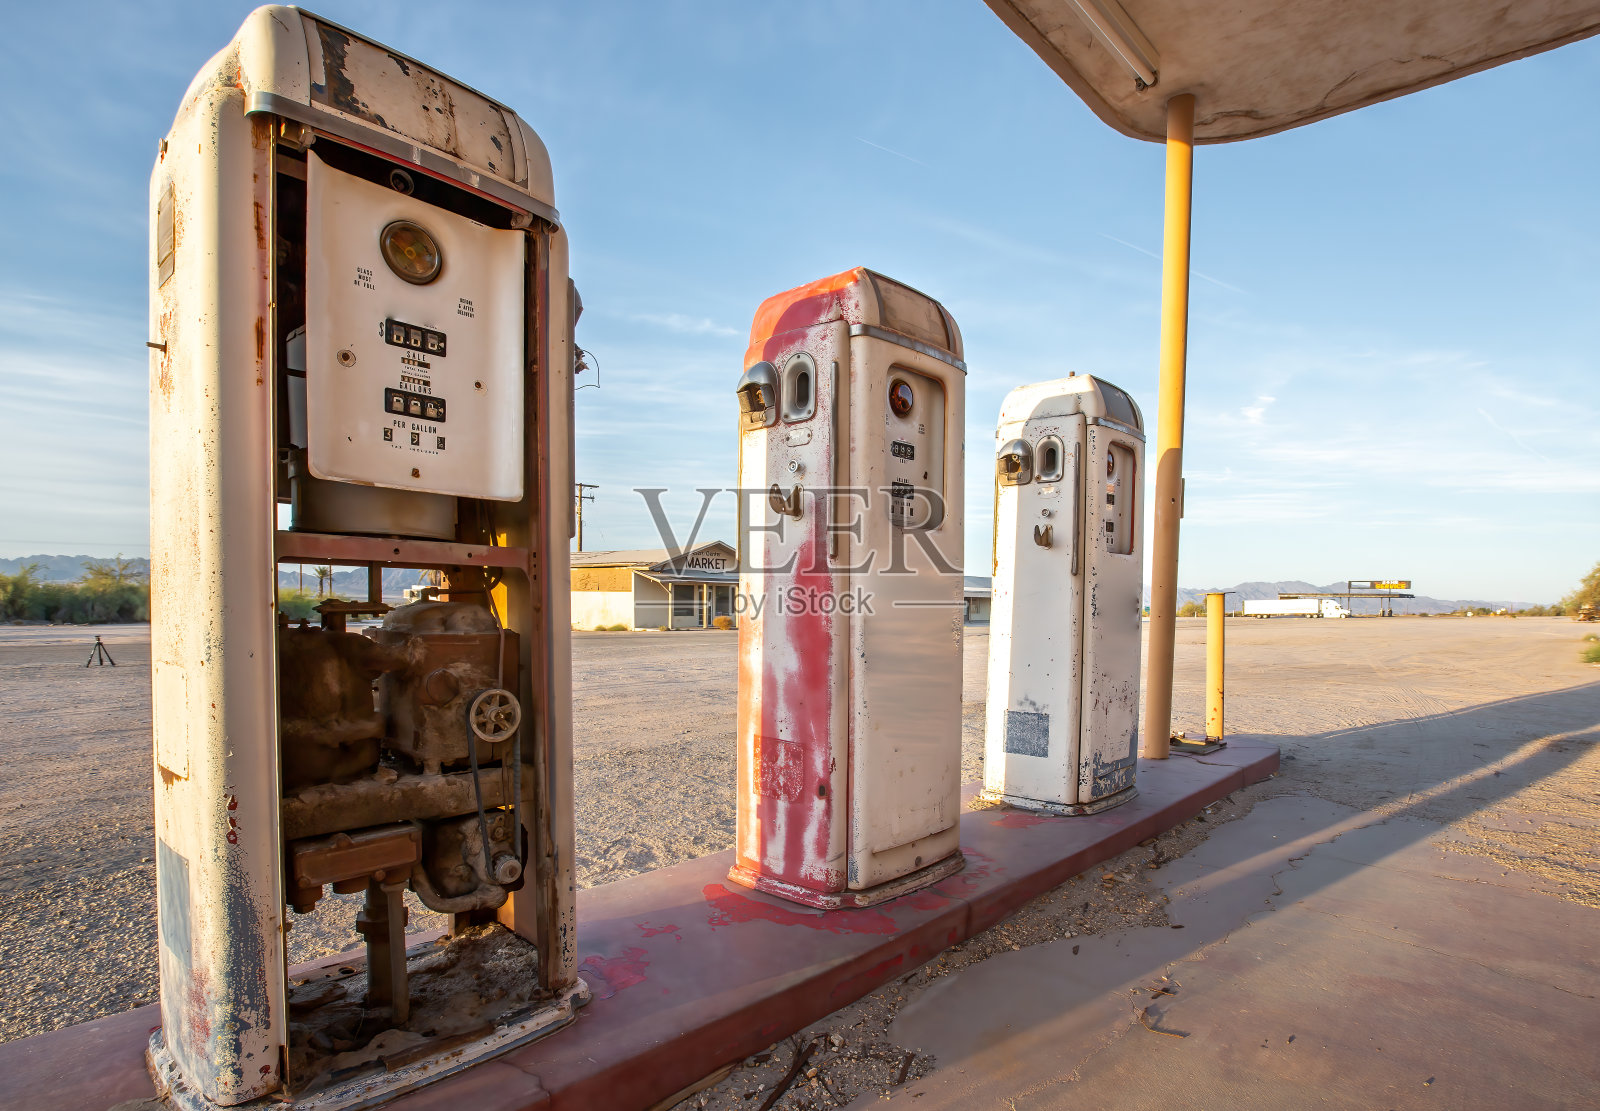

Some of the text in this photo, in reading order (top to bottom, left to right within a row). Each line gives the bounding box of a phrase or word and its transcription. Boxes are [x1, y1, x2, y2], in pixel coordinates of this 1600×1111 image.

[356, 266, 372, 276] GLASS
[406, 350, 426, 362] SALE
[399, 381, 432, 395] GALLONS
[393, 419, 437, 435] PER GALLON
[685, 556, 727, 570] MARKET
